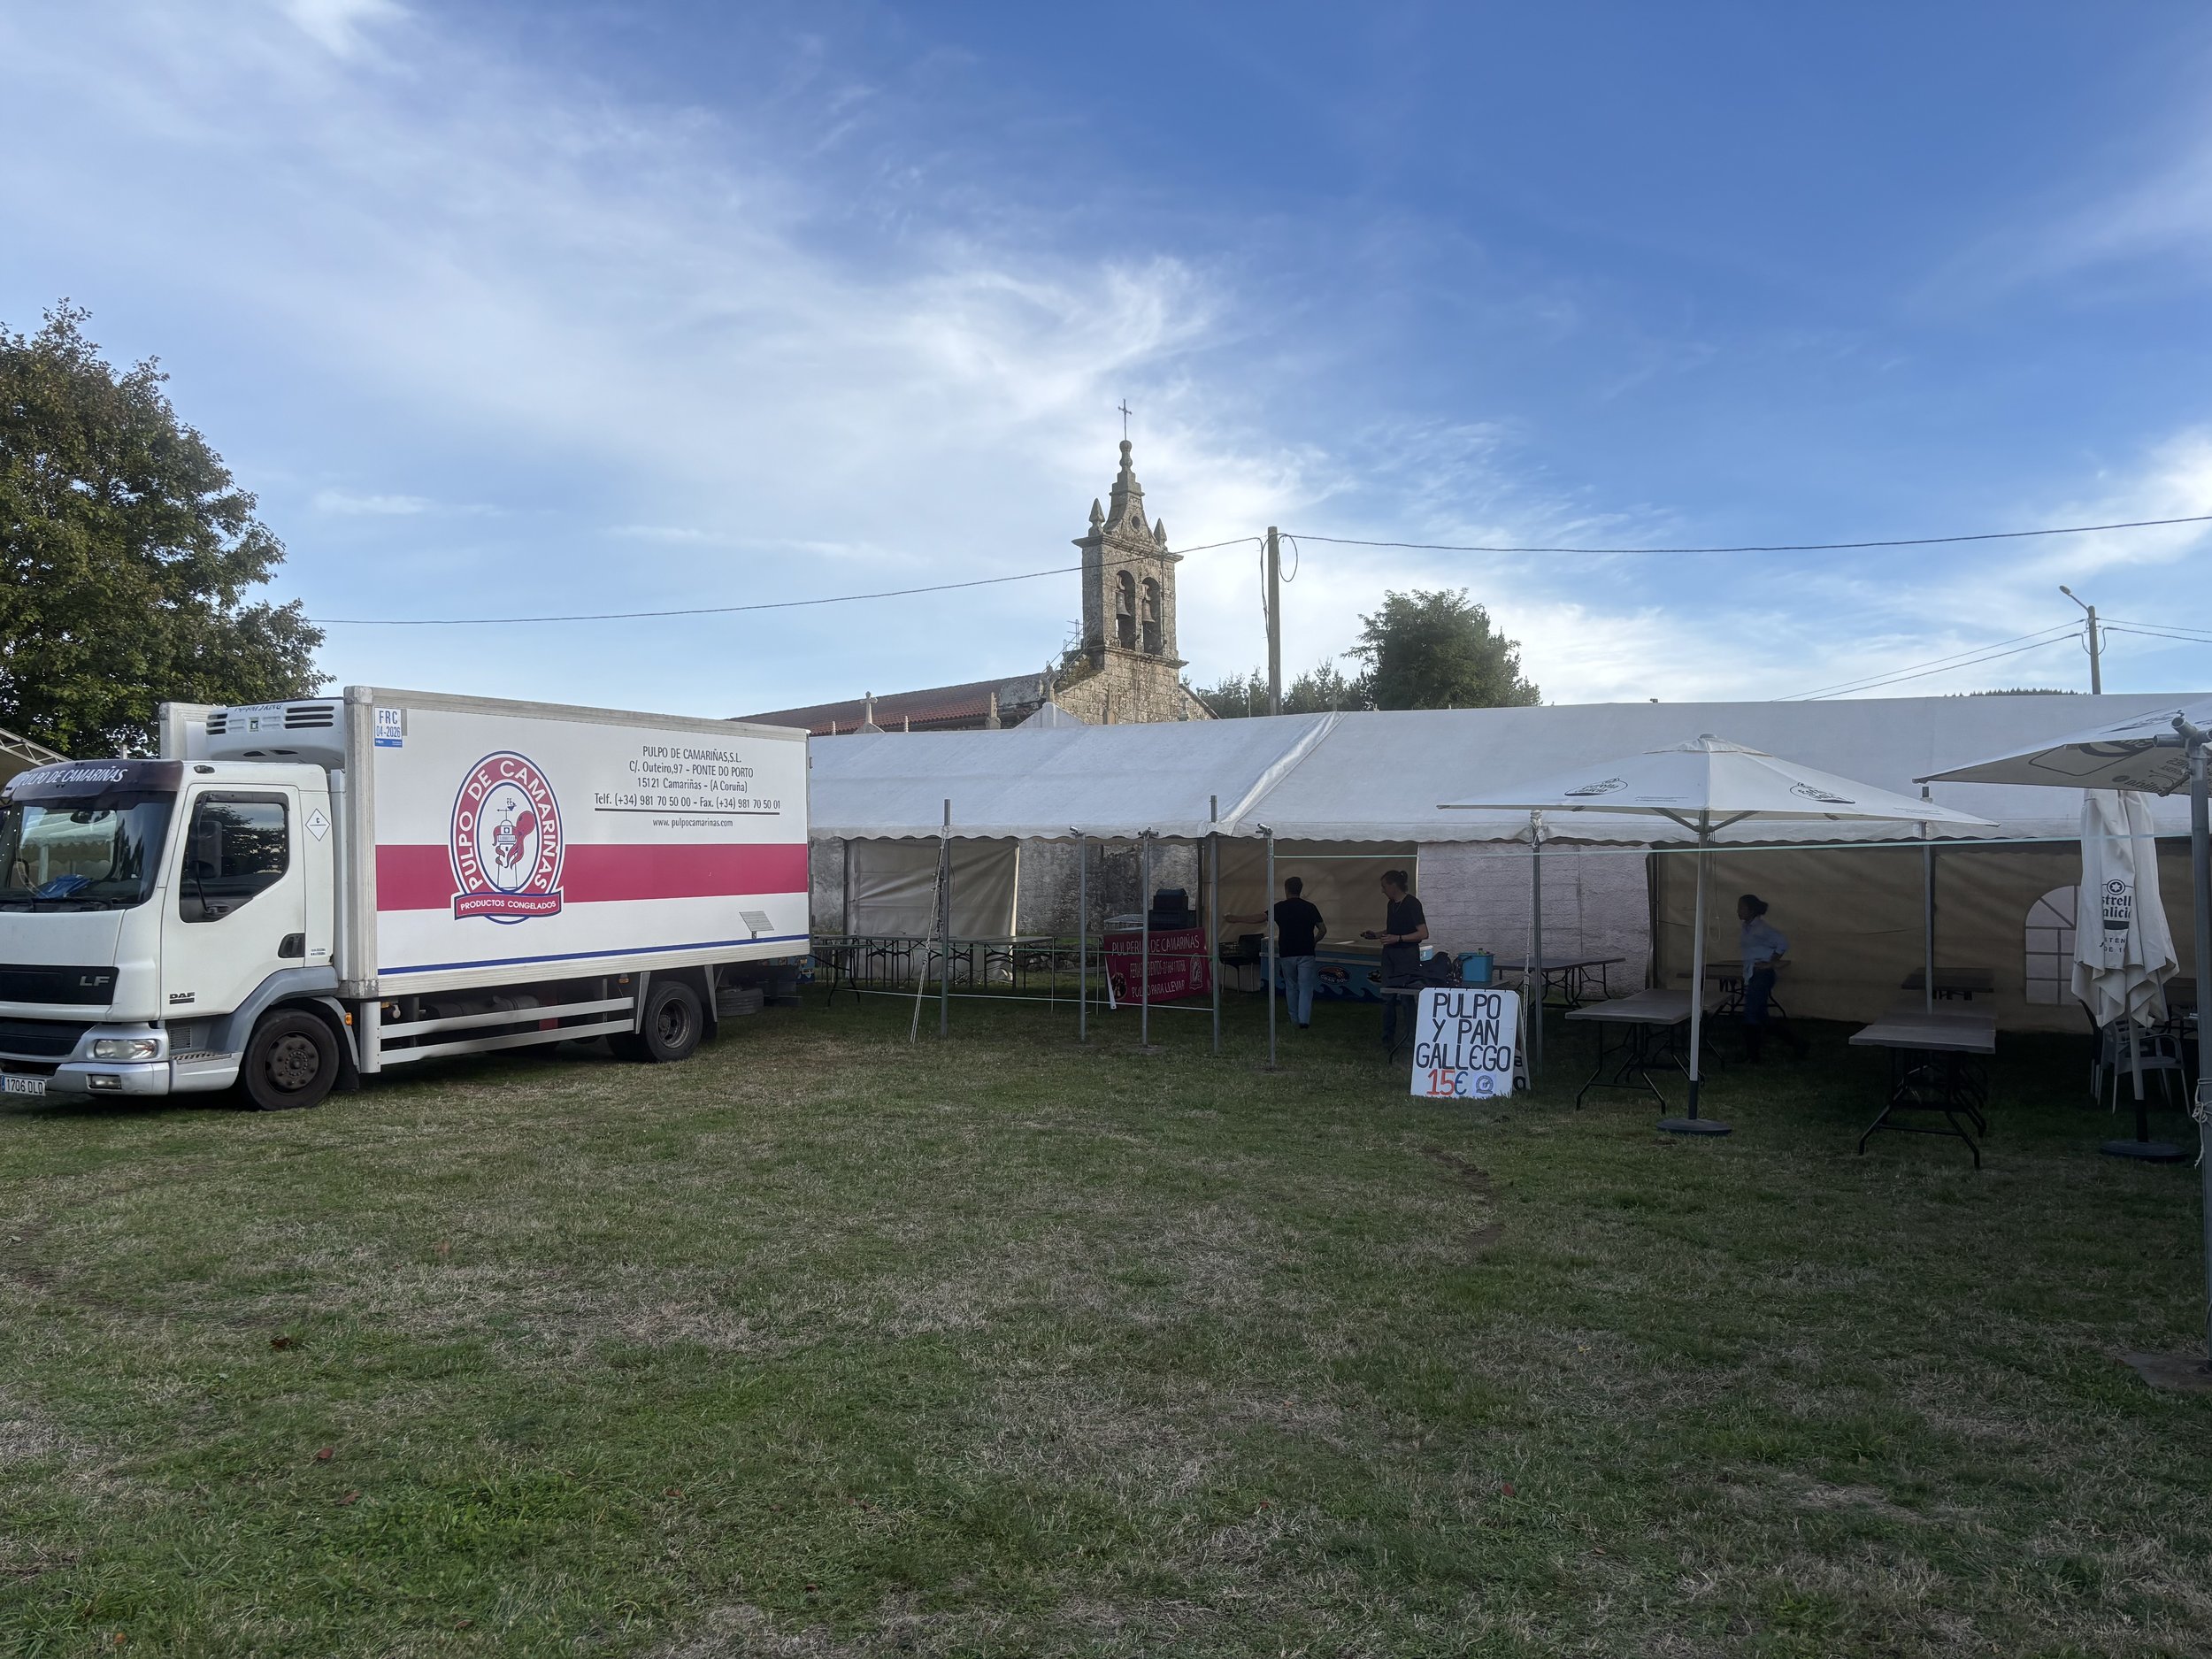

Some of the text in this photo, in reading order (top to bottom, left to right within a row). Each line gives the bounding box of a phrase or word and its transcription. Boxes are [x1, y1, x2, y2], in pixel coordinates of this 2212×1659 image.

[379, 710, 398, 724] FRC
[376, 726, 401, 738] 04-2026
[642, 746, 741, 763] PULPO DE CAMARIÑAS,S.L.
[19, 765, 128, 787] PULPO DE CAMARIÑAS
[629, 760, 641, 773] C/.
[642, 761, 683, 774] Outeiro,97
[692, 764, 716, 776] PONTE
[718, 765, 729, 777] DO
[731, 766, 754, 778] PORTO
[637, 778, 659, 788] 15121
[663, 778, 702, 790] Camariñas
[710, 780, 718, 792] (A
[719, 780, 748, 794] Coruña)
[595, 793, 612, 804] Telf.
[614, 792, 637, 807] (+34)
[640, 795, 654, 806] 981
[657, 795, 667, 806] 70
[669, 796, 679, 807] 50
[680, 797, 691, 807] 00
[700, 796, 714, 808] Fax.
[716, 796, 736, 810] (+34)
[738, 798, 749, 809] 981
[753, 799, 762, 809] 70
[763, 800, 772, 809] 50
[773, 800, 780, 809] 01
[458, 760, 558, 891] PULPO DE CAMARIÑAS
[460, 899, 557, 910] PRODUCTOS CONGELADOS
[1112, 941, 1149, 956] PULPERI
[1151, 939, 1160, 953] DE
[80, 976, 110, 987] LF
[1131, 984, 1151, 998] PULO
[1432, 993, 1502, 1019] PULPO
[1432, 1018, 1500, 1045] Y PAN
[1416, 1042, 1511, 1071] GALLEGO
[7, 1079, 26, 1092] 1706
[1426, 1068, 1469, 1095] 15€
